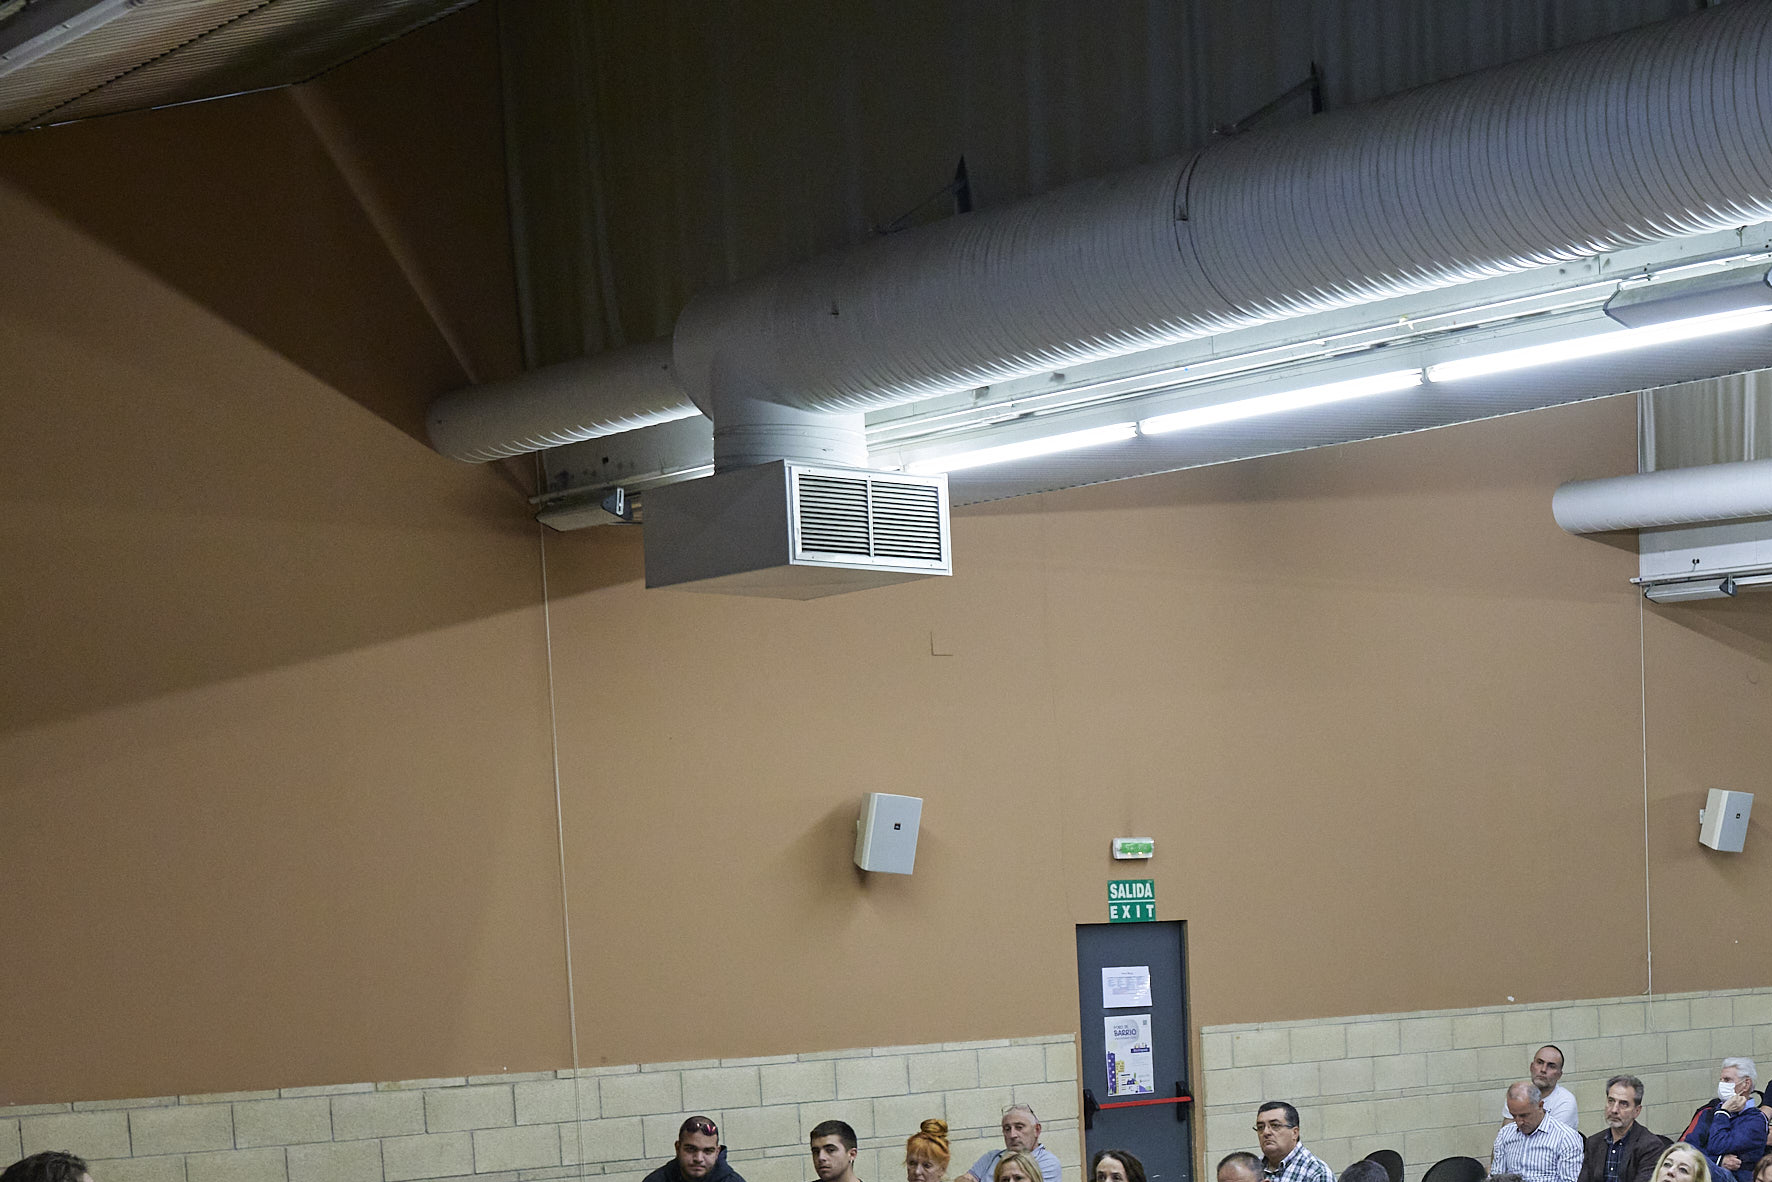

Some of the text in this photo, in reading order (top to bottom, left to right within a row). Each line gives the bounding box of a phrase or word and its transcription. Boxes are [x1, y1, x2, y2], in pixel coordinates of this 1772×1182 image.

[1110, 883, 1153, 899] SALIDA
[1110, 904, 1154, 919] EXIT
[1113, 1028, 1137, 1037] BARRIO
